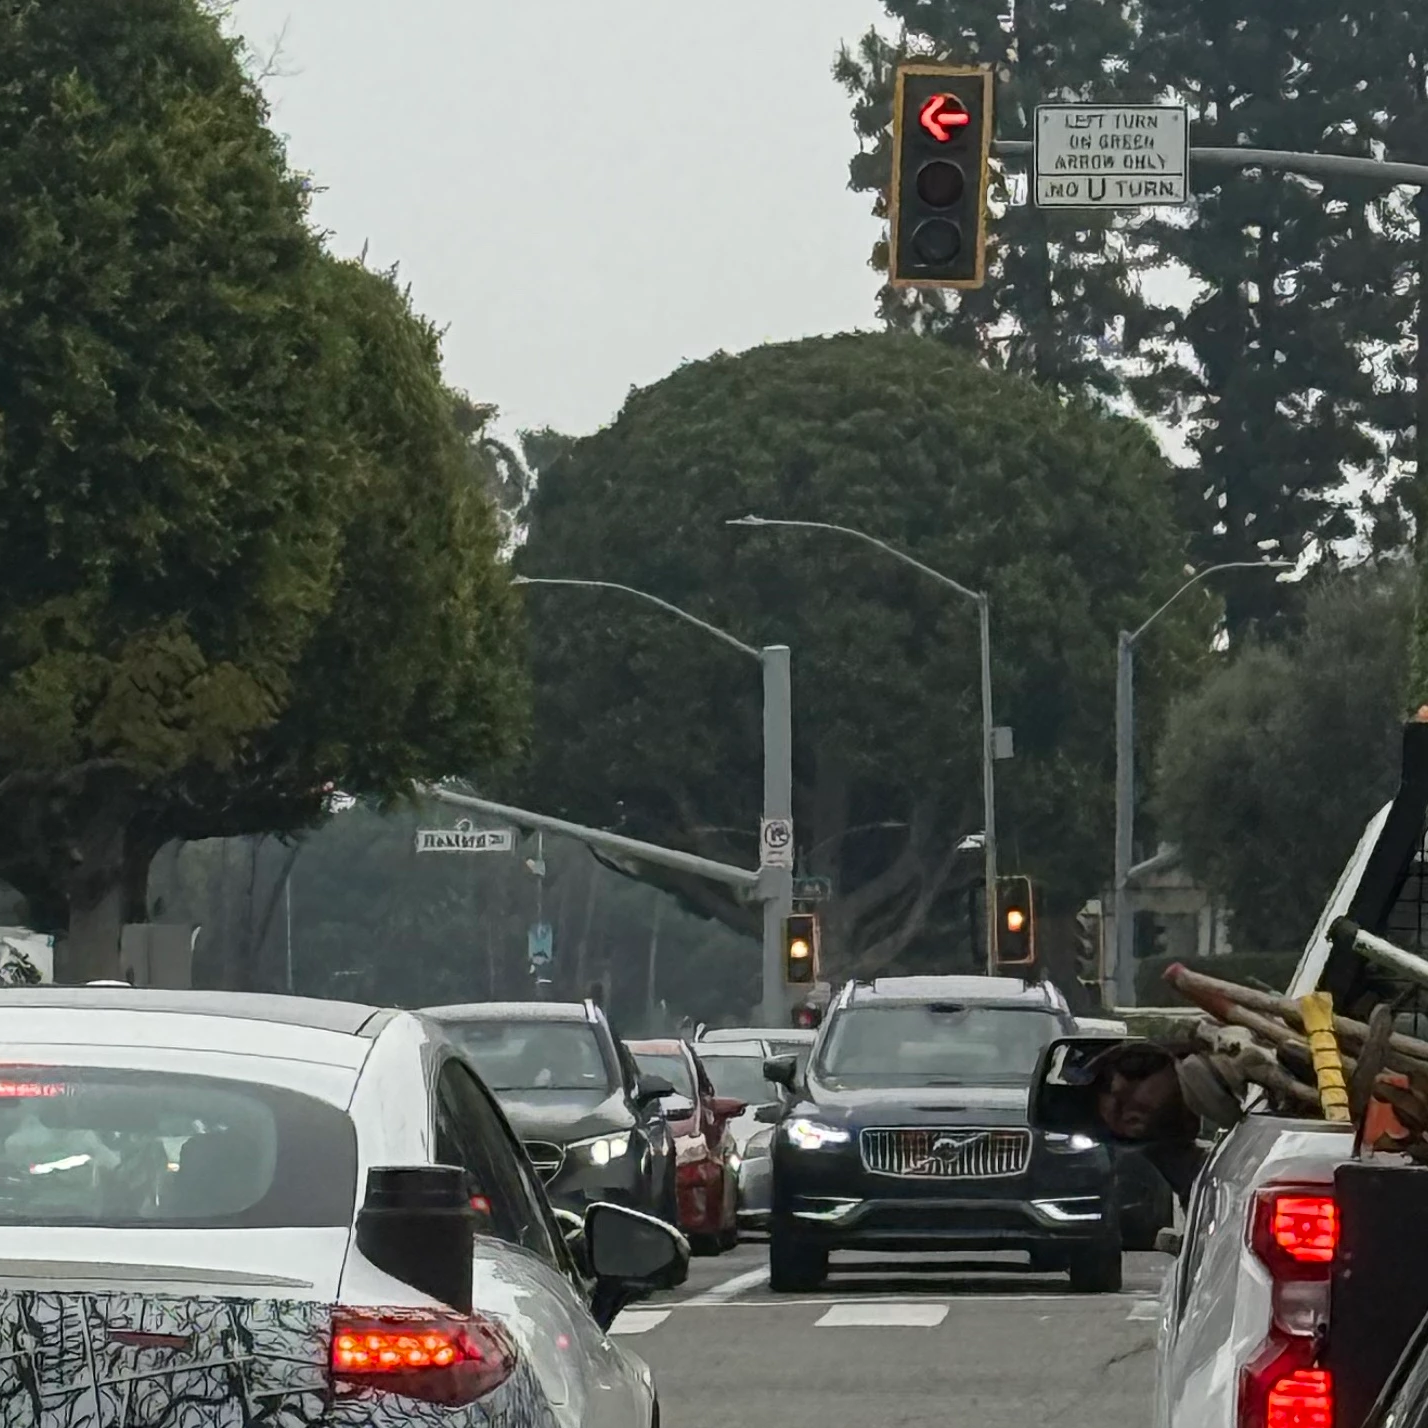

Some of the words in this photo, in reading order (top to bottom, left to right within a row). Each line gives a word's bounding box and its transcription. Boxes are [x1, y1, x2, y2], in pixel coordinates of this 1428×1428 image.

[1065, 114, 1106, 129] LEFT
[1115, 114, 1158, 129] TURN
[1069, 134, 1092, 149] ON
[1099, 134, 1155, 150] GREEN
[1055, 154, 1116, 170] ARROW
[1123, 153, 1168, 170] ONLY
[1049, 181, 1079, 198] NO
[1088, 177, 1106, 201] U
[1115, 180, 1174, 198] TURN
